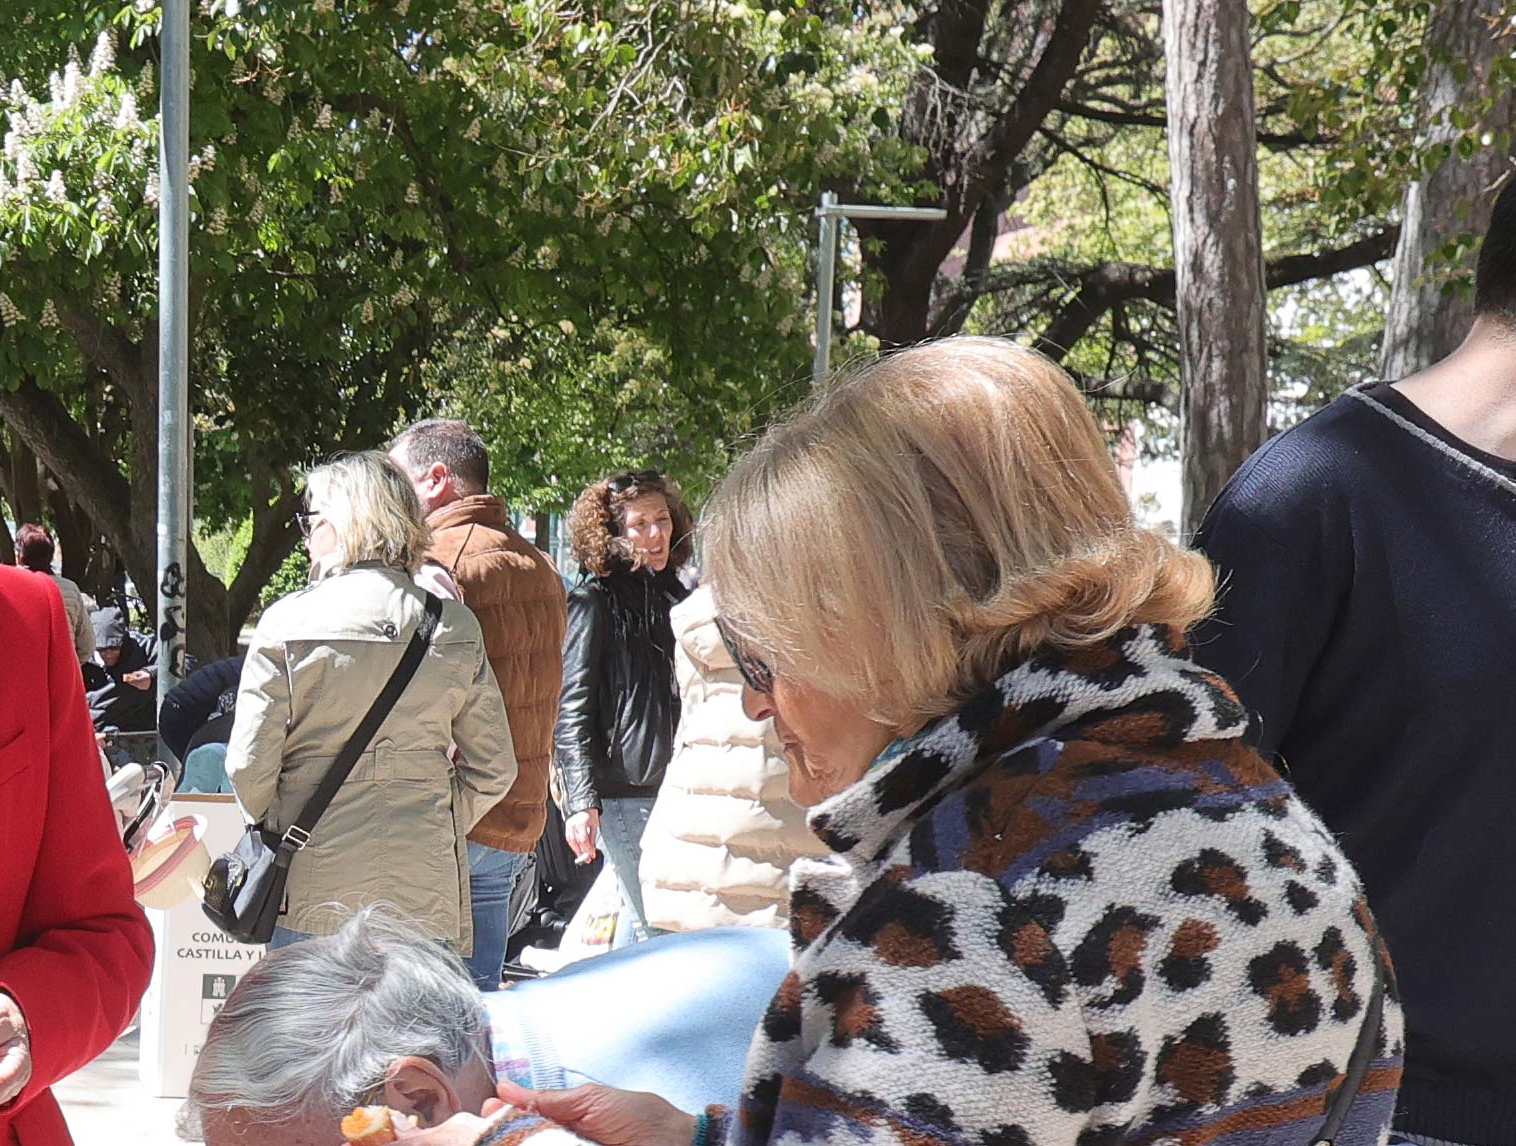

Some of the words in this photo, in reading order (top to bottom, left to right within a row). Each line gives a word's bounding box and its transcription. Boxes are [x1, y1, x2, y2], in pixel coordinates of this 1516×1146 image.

[192, 932, 239, 944] COMU
[177, 948, 242, 960] CASTILLA
[246, 950, 255, 960] Y
